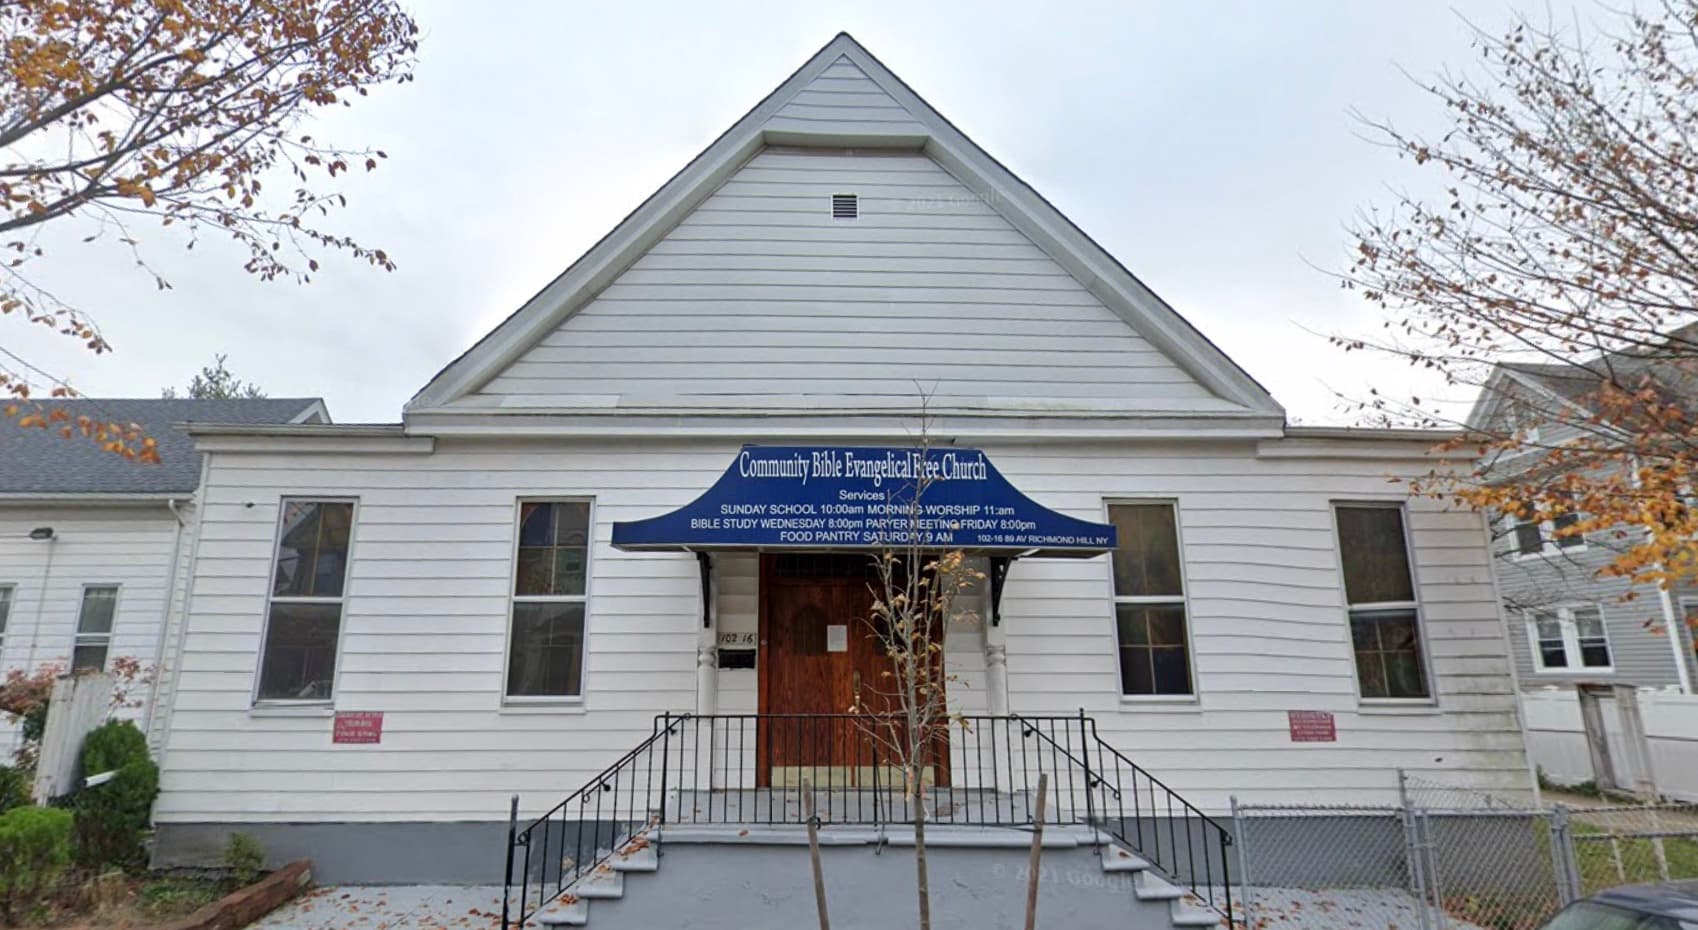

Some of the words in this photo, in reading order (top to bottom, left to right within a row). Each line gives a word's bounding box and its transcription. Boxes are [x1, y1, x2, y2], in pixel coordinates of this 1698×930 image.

[739, 450, 810, 485] Community
[812, 451, 842, 477] Bible
[845, 452, 911, 487] Evangelical
[912, 453, 940, 479] Free
[942, 453, 987, 480] Church
[839, 490, 885, 501] Services
[720, 504, 766, 515] SUNDAY
[769, 504, 817, 515] SCHOOL
[820, 504, 864, 515] 10:00am
[867, 504, 923, 515] MORNING
[925, 505, 980, 516] WORSHIP
[984, 505, 1014, 516] 11:am
[691, 518, 720, 529] BIBLE
[723, 518, 758, 529] STUDY
[761, 518, 826, 529] WEDNESDAY
[828, 518, 863, 531] 8:00pm
[866, 519, 908, 529] PARYER
[960, 519, 998, 530] FRIDAY
[1000, 519, 1036, 532] 8:00pm
[780, 531, 813, 542] FOOD
[815, 531, 860, 542] PANTRY
[863, 531, 924, 542] SATURDAY
[926, 532, 933, 542] 9
[935, 532, 953, 542] AM
[1016, 535, 1027, 544] AV
[1028, 535, 1074, 545] RICHMOND
[1076, 536, 1095, 545] HILL
[1096, 536, 1109, 546] NY
